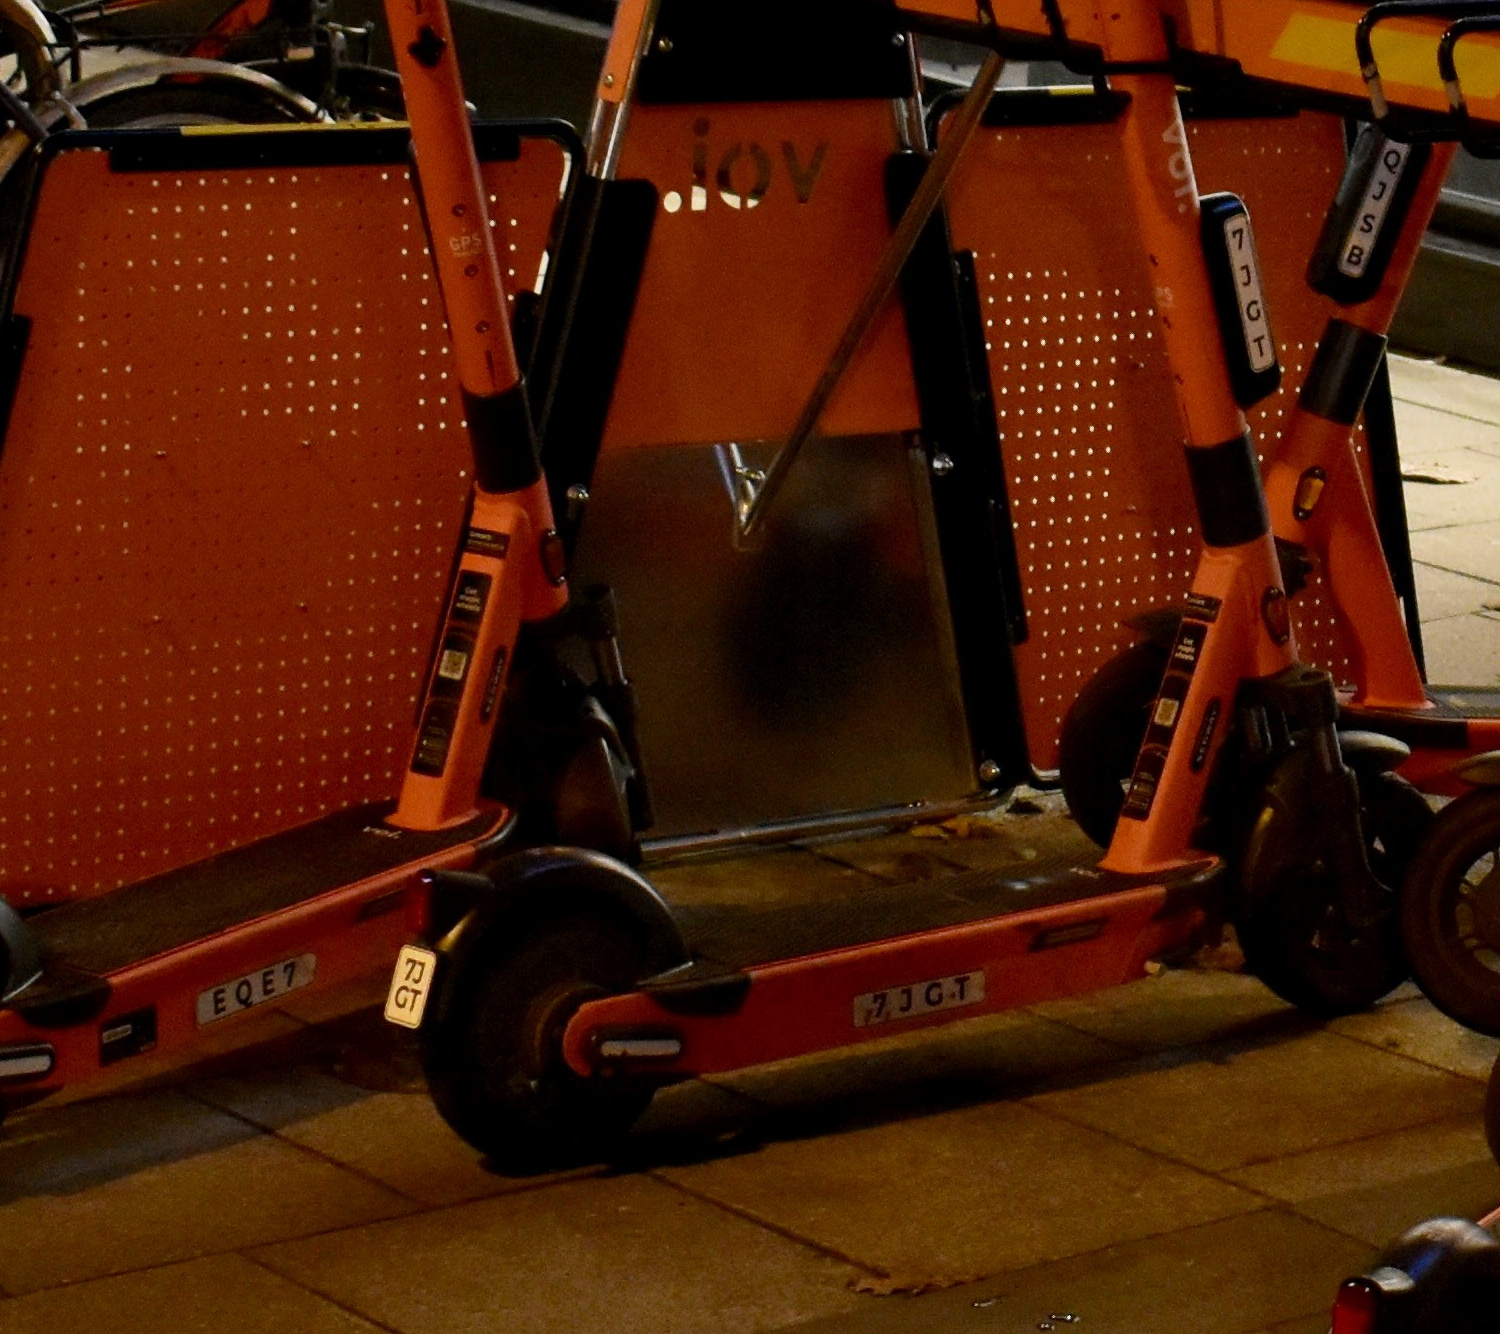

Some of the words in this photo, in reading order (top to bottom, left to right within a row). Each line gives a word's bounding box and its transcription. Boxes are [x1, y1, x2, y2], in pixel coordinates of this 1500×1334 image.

[213, 961, 296, 1015] EQE7
[405, 957, 426, 984] 7J
[395, 985, 422, 1012] GT
[873, 975, 970, 1018] 7JGT
